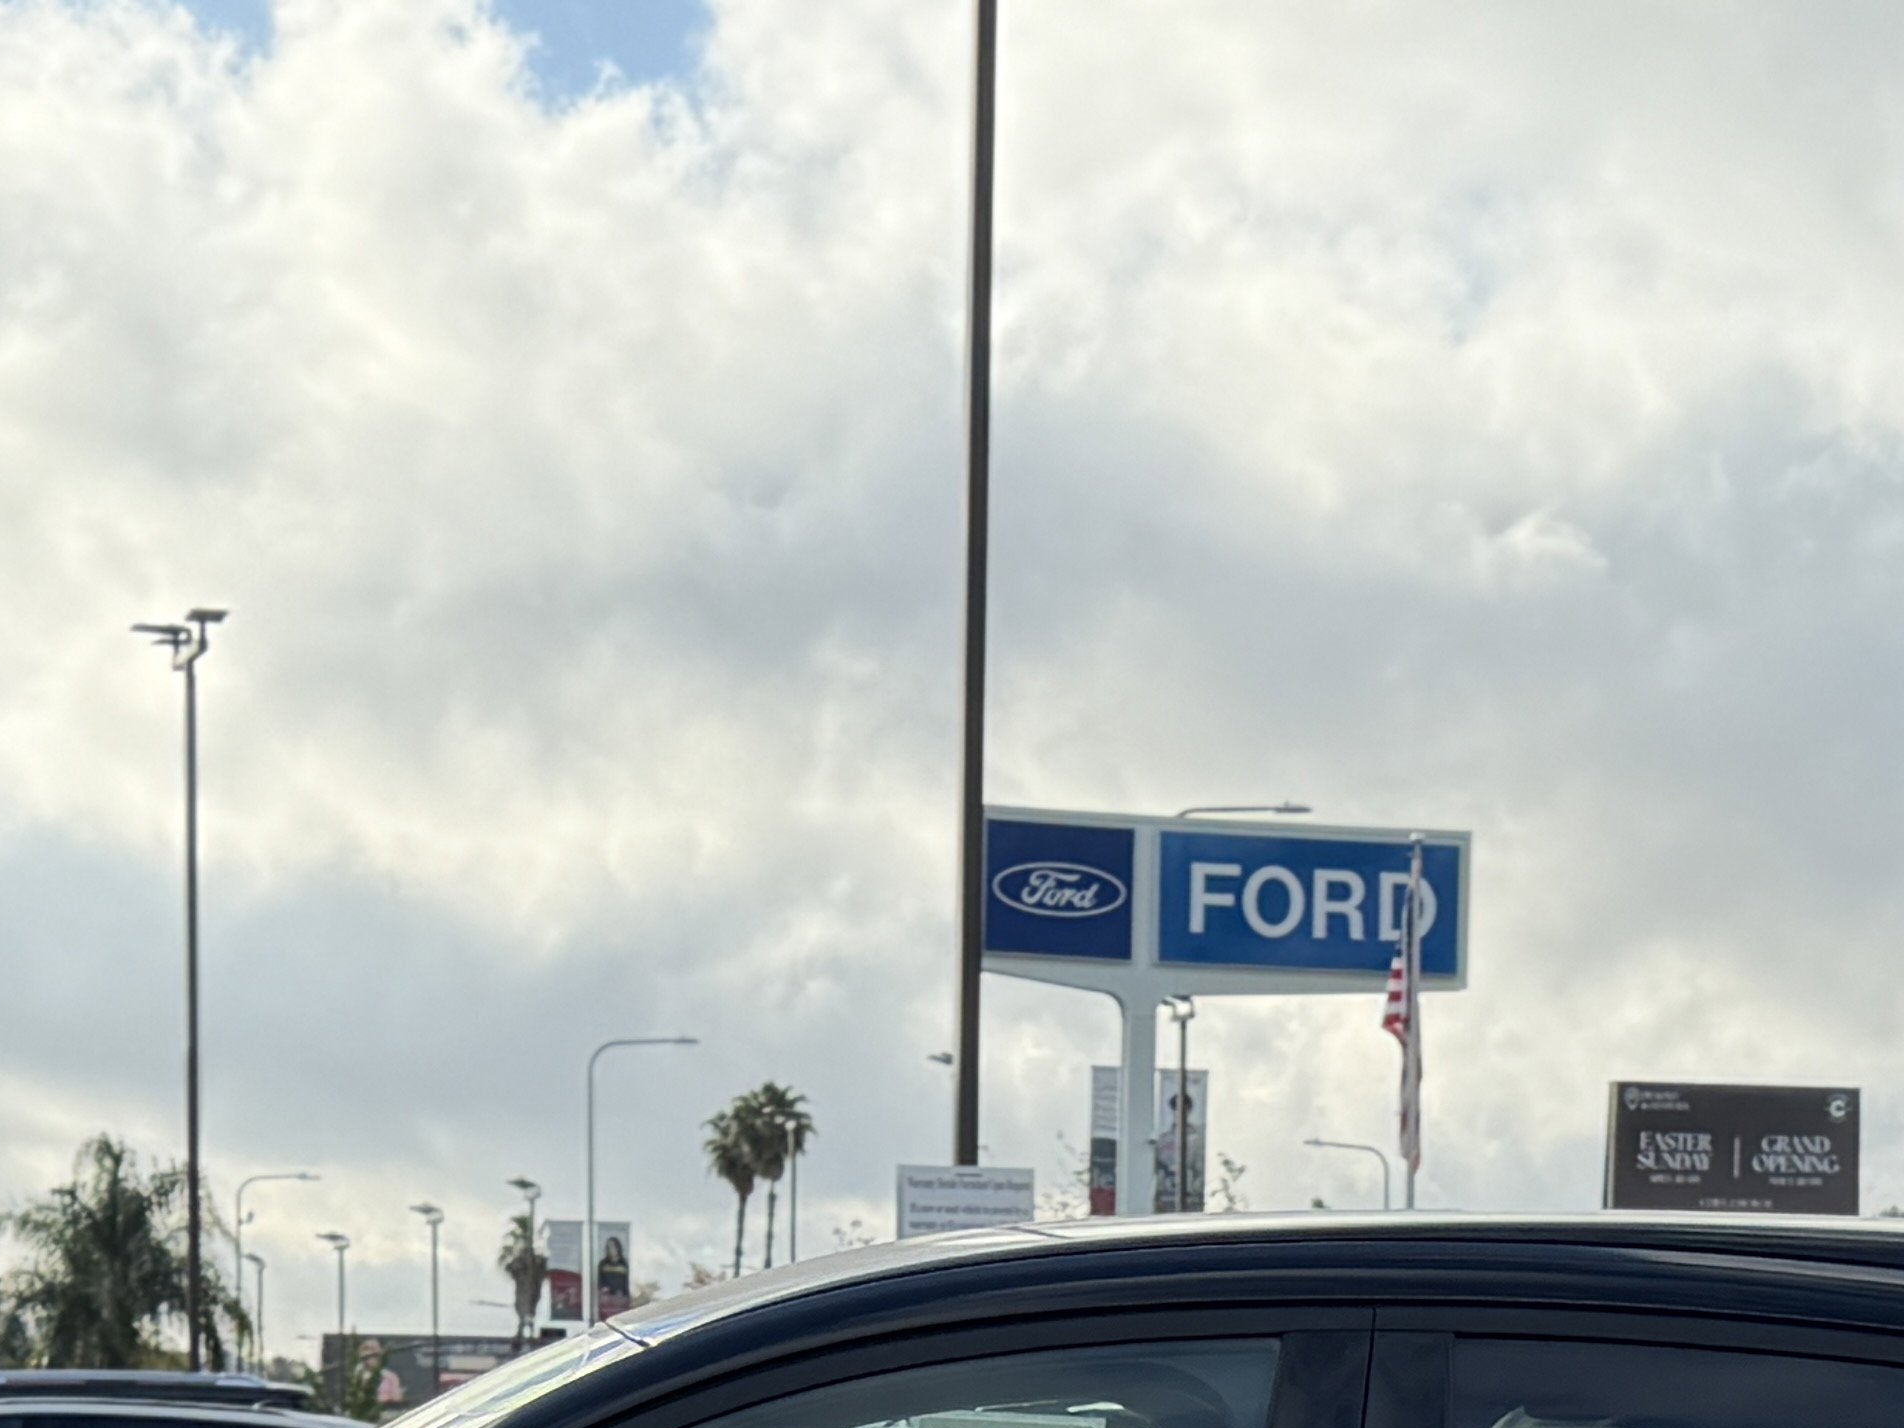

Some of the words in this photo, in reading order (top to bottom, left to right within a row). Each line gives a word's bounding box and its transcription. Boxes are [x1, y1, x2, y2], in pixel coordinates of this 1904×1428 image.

[1021, 869, 1100, 908] Ford
[1189, 861, 1438, 941] FORD
[1639, 1130, 1712, 1151] EASTER
[1760, 1134, 1832, 1154] GRAND
[1636, 1150, 1712, 1171] SUNDAY
[1751, 1152, 1841, 1174] OPENING
